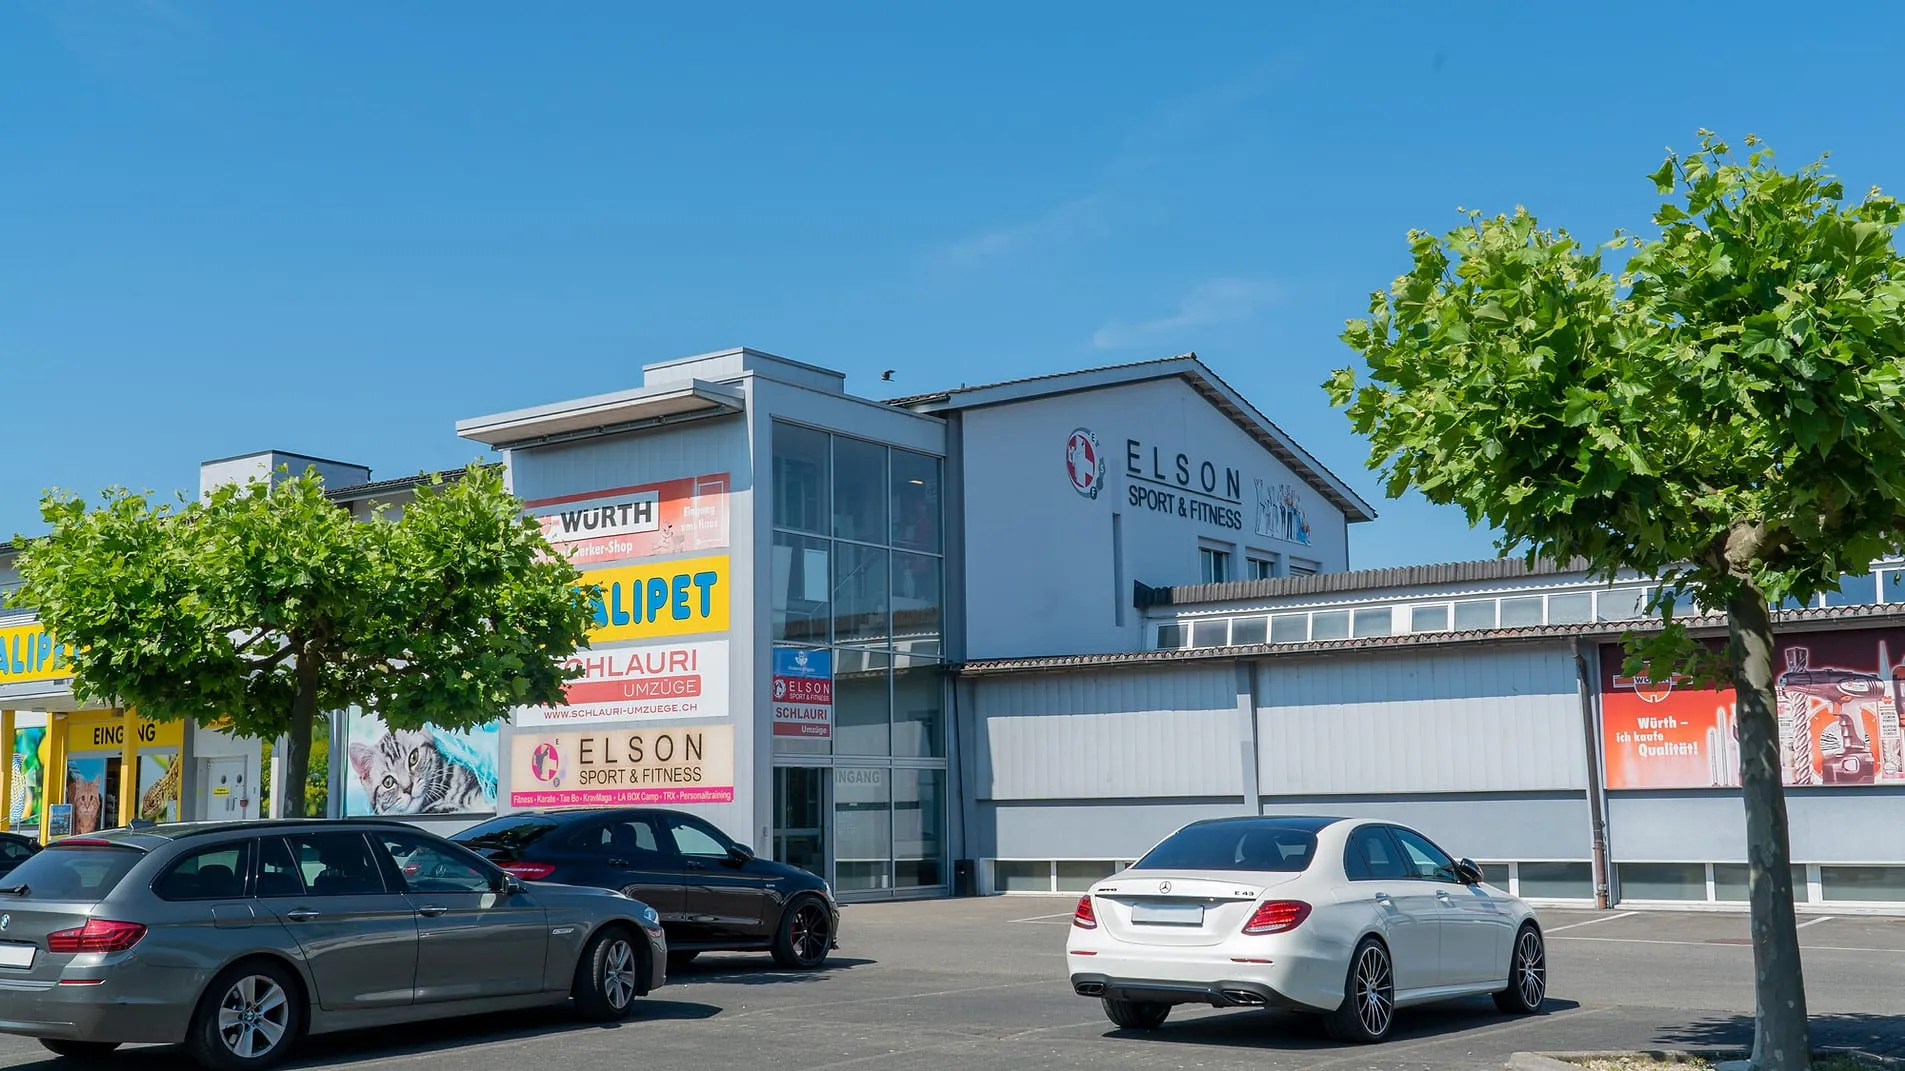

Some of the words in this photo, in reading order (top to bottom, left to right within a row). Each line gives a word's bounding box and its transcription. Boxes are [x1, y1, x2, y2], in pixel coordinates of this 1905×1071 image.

[1127, 438, 1240, 499] ELSON
[1128, 485, 1175, 514] SPORT
[1178, 497, 1187, 517] &
[1190, 500, 1242, 530] FITNESS
[560, 500, 653, 533] WÜRTH
[624, 679, 697, 697] UMZÜGE
[790, 681, 830, 694] ELSON
[544, 704, 698, 719] WWW.SCHLAURI-UMZUEGE.CH
[775, 707, 828, 720] SCHLAURI
[801, 725, 827, 735] Umzüge
[1637, 716, 1677, 729] Würth
[93, 723, 156, 745] EINGNG
[1616, 732, 1631, 742] ich
[1633, 730, 1664, 742] kaufe
[580, 734, 702, 764] ELSON
[1638, 741, 1698, 757] Qualität!
[579, 769, 625, 785] SPORT
[629, 769, 639, 783] &
[643, 766, 703, 783] FITNESS
[663, 791, 675, 800] TRX
